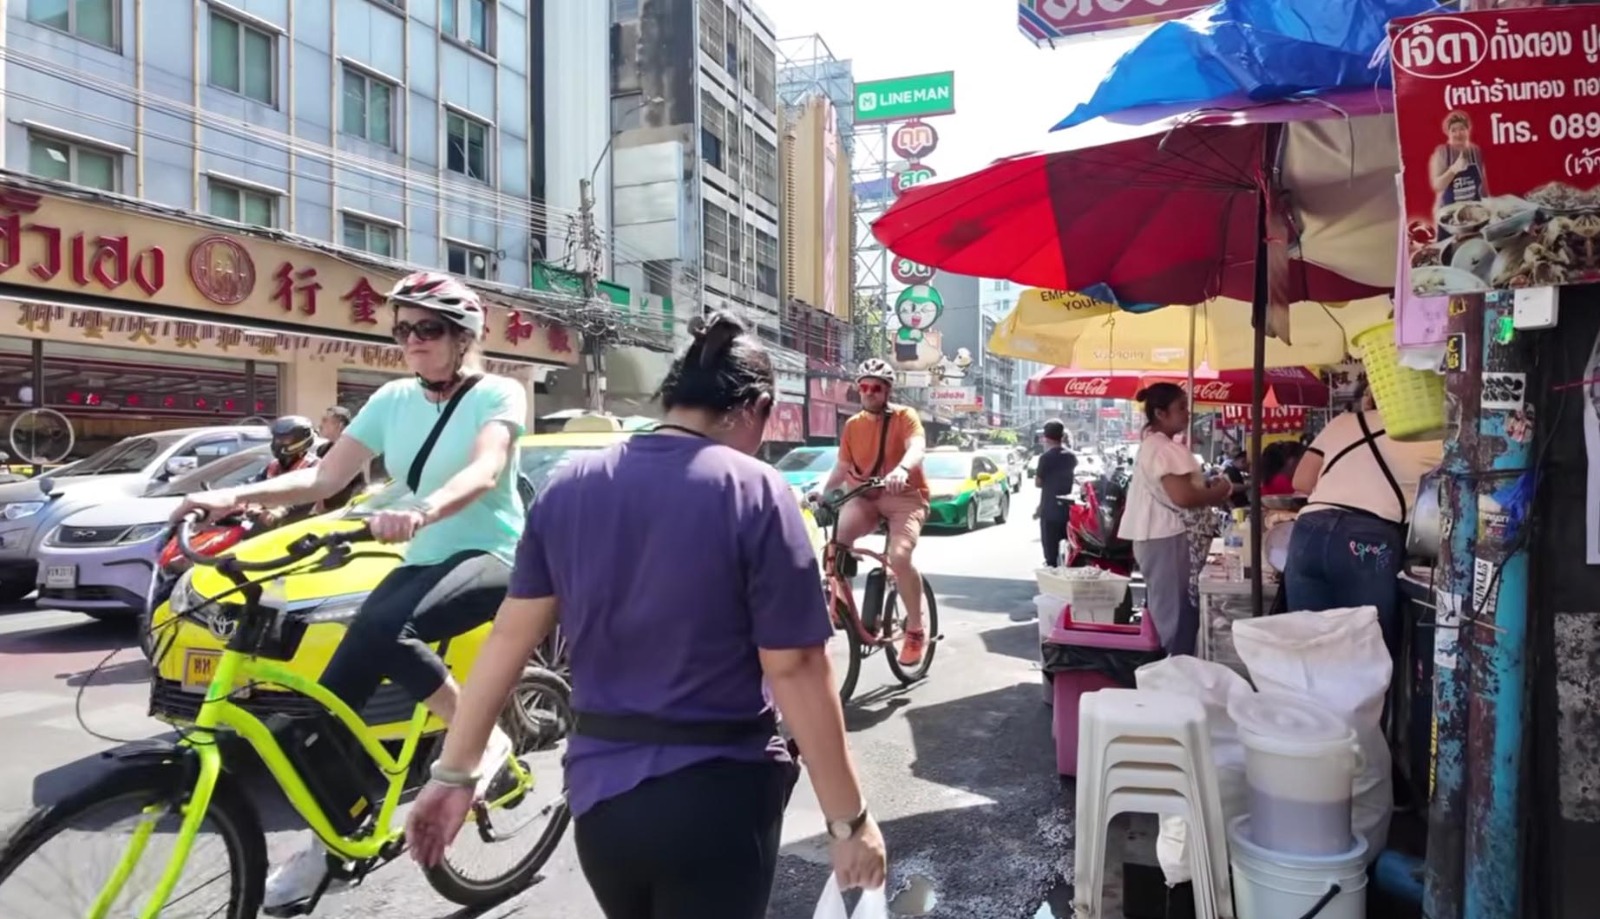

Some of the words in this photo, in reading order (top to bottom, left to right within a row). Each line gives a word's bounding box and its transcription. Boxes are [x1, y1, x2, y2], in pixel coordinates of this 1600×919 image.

[1402, 24, 1479, 68] เจ๊ดา
[1490, 19, 1572, 61] กั้งดอง
[1582, 24, 1600, 63] ปู
[880, 90, 912, 106] LINE
[913, 86, 949, 102] MAN
[1444, 78, 1565, 110] (หน้าร้านทอง
[1574, 77, 1600, 97] ทอ
[1490, 113, 1539, 145] โทร.
[1550, 112, 1600, 140] 089
[1040, 290, 1078, 302] EMPO
